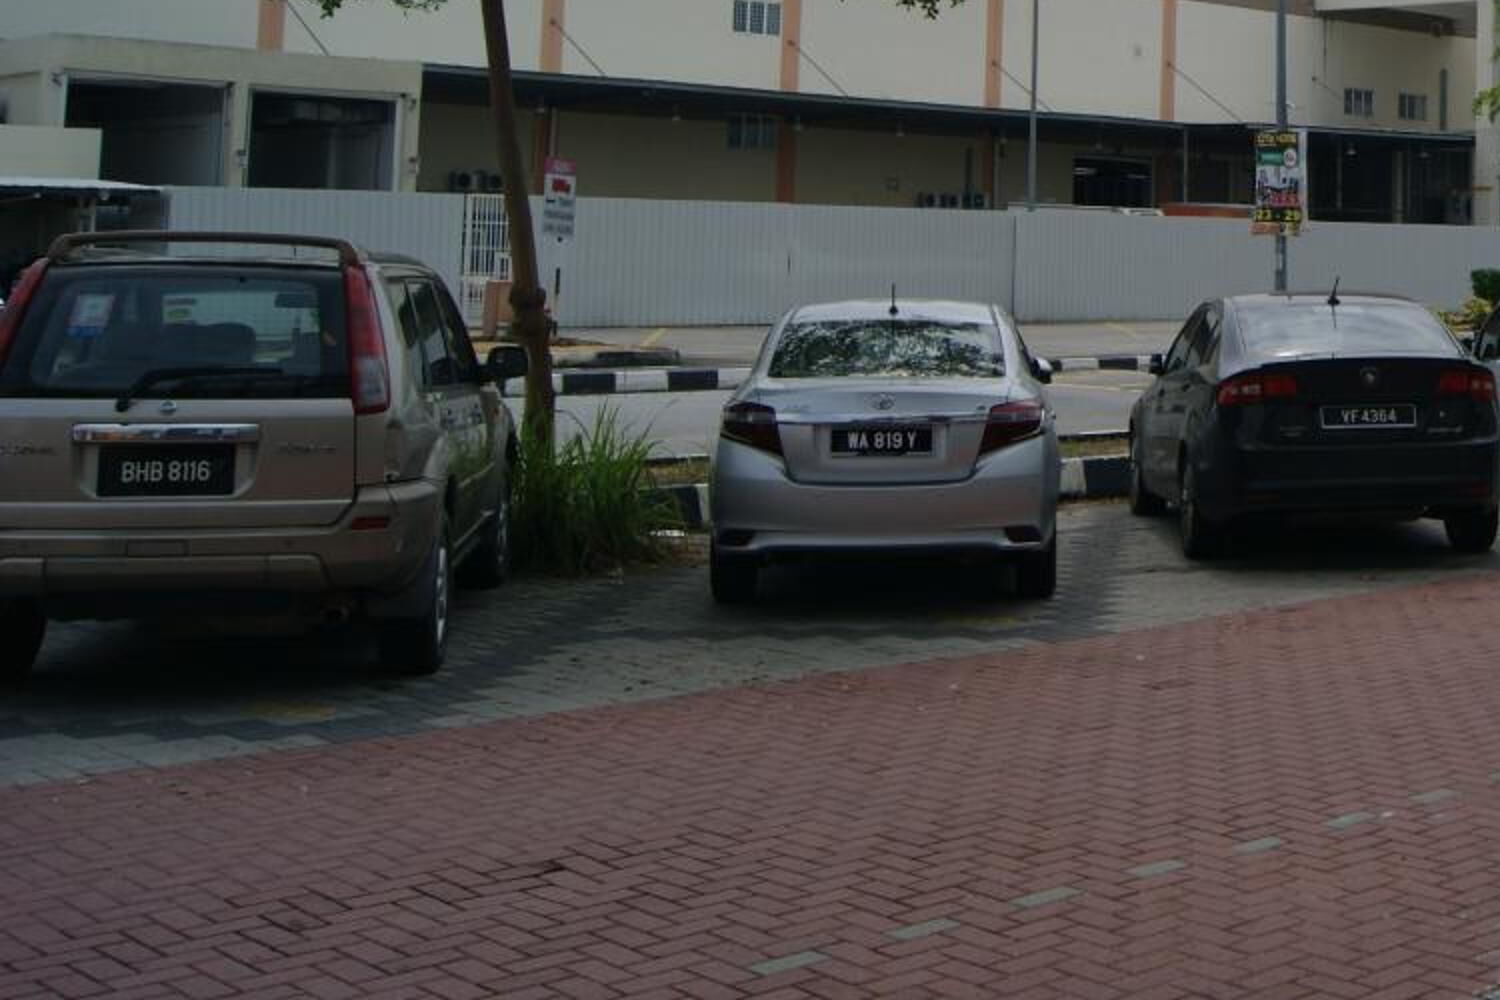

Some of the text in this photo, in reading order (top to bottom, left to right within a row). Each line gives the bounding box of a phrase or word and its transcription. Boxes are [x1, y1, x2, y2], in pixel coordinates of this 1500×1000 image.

[848, 431, 916, 449] WA 819 Y
[121, 460, 210, 482] BHB 8116
